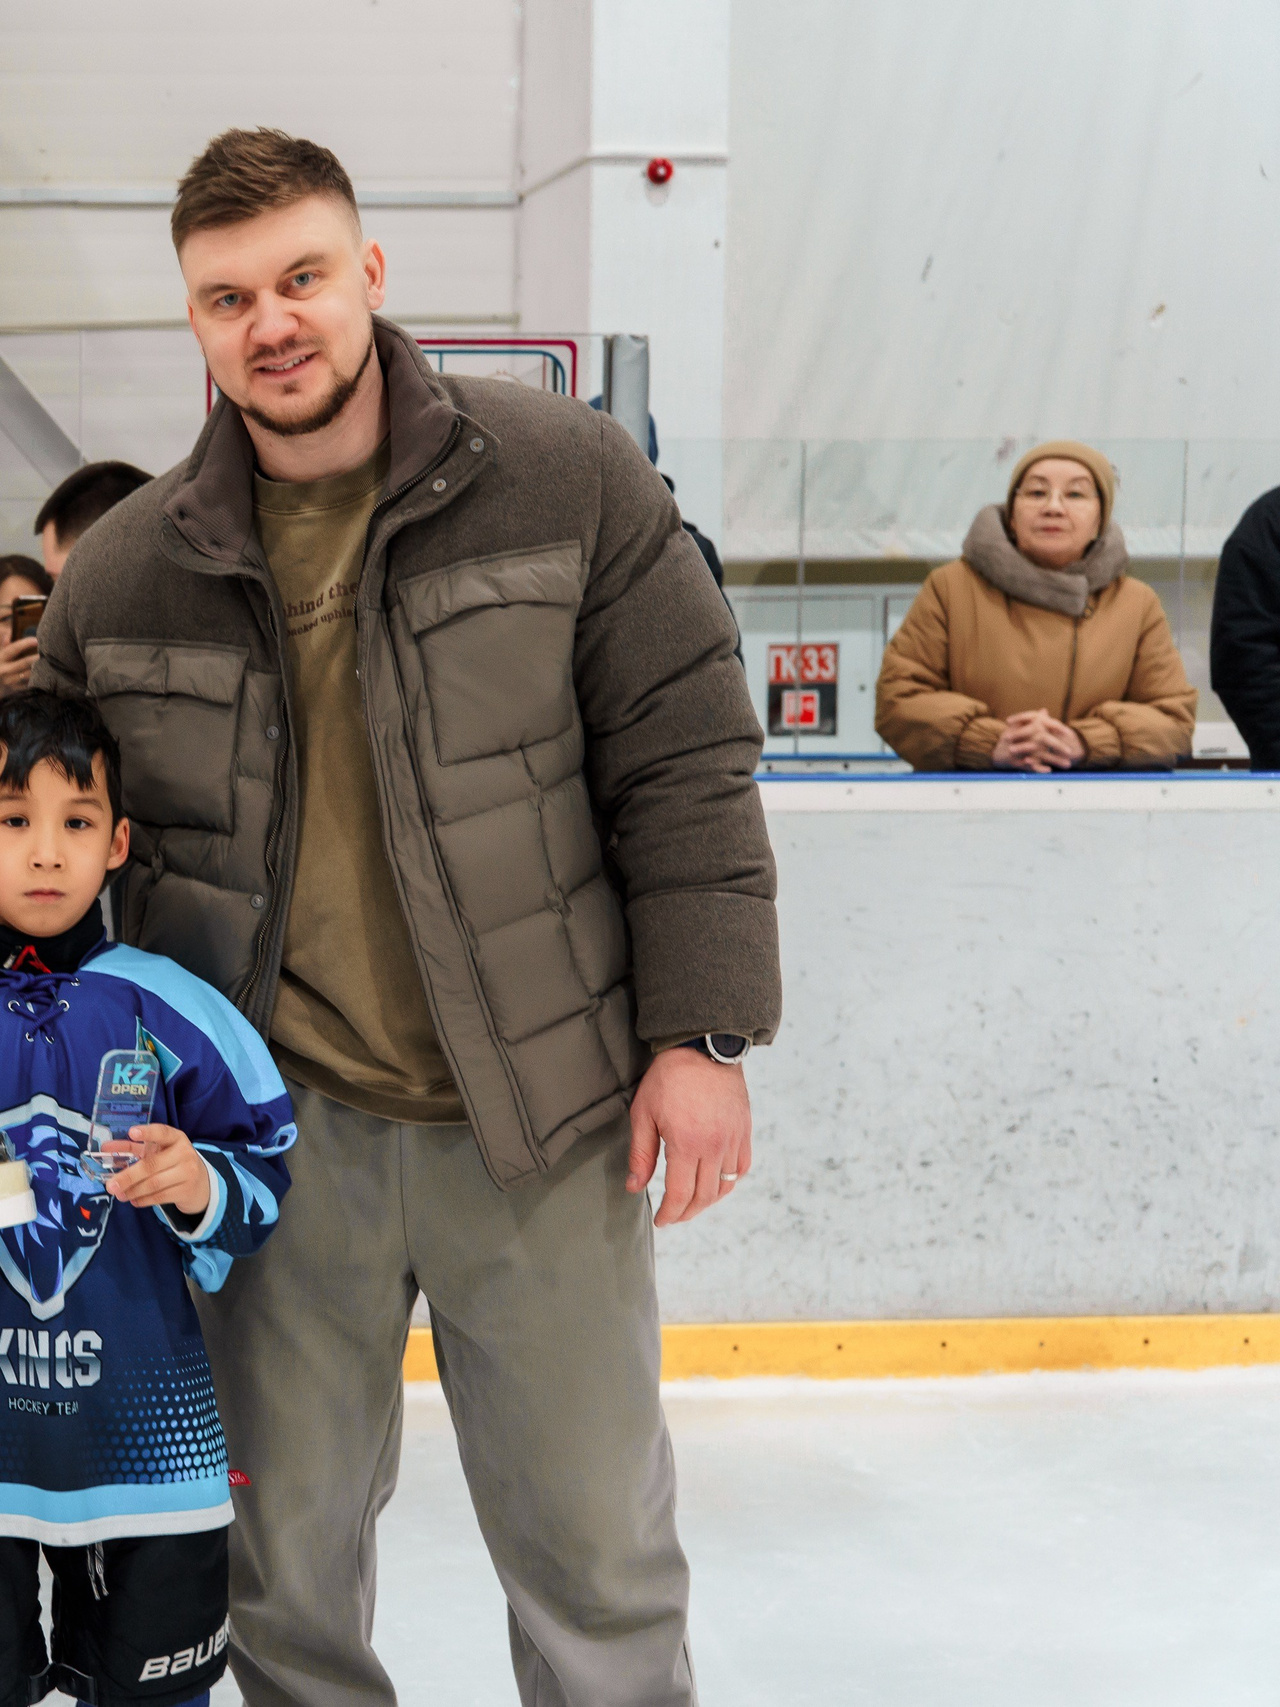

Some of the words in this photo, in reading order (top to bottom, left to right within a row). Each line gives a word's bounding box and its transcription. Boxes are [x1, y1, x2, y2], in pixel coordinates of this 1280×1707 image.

[283, 591, 325, 617] hind
[111, 1062, 152, 1085] KZ
[111, 1084, 149, 1096] OPEN
[8, 1396, 51, 1416] HOCKEY
